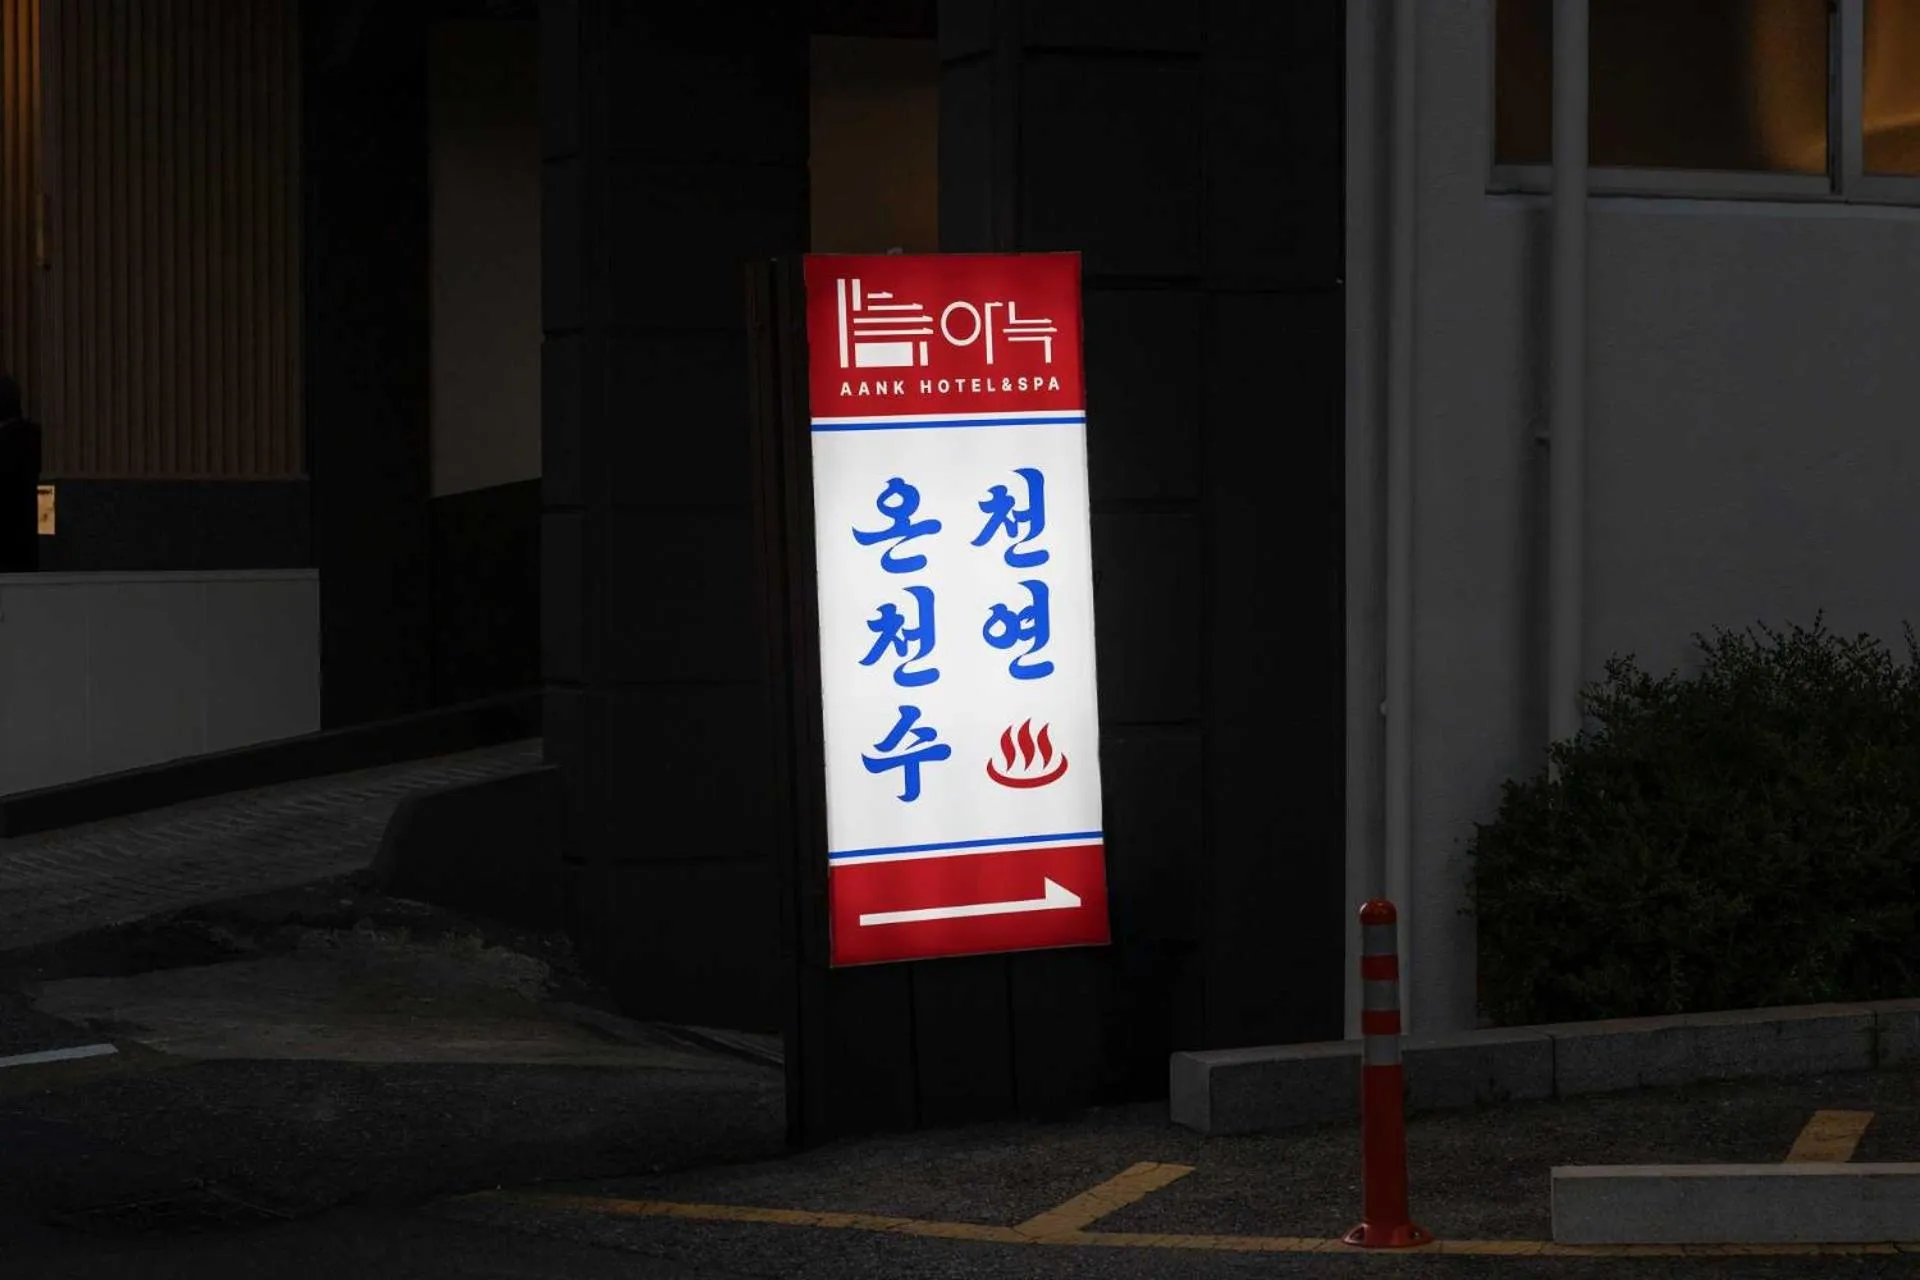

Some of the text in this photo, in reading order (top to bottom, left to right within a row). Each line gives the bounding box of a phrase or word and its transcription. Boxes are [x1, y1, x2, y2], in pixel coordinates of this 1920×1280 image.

[840, 376, 1060, 396] AANK HOTEL&SPA
[852, 477, 952, 802] 온천수
[970, 467, 1054, 680] 천연
